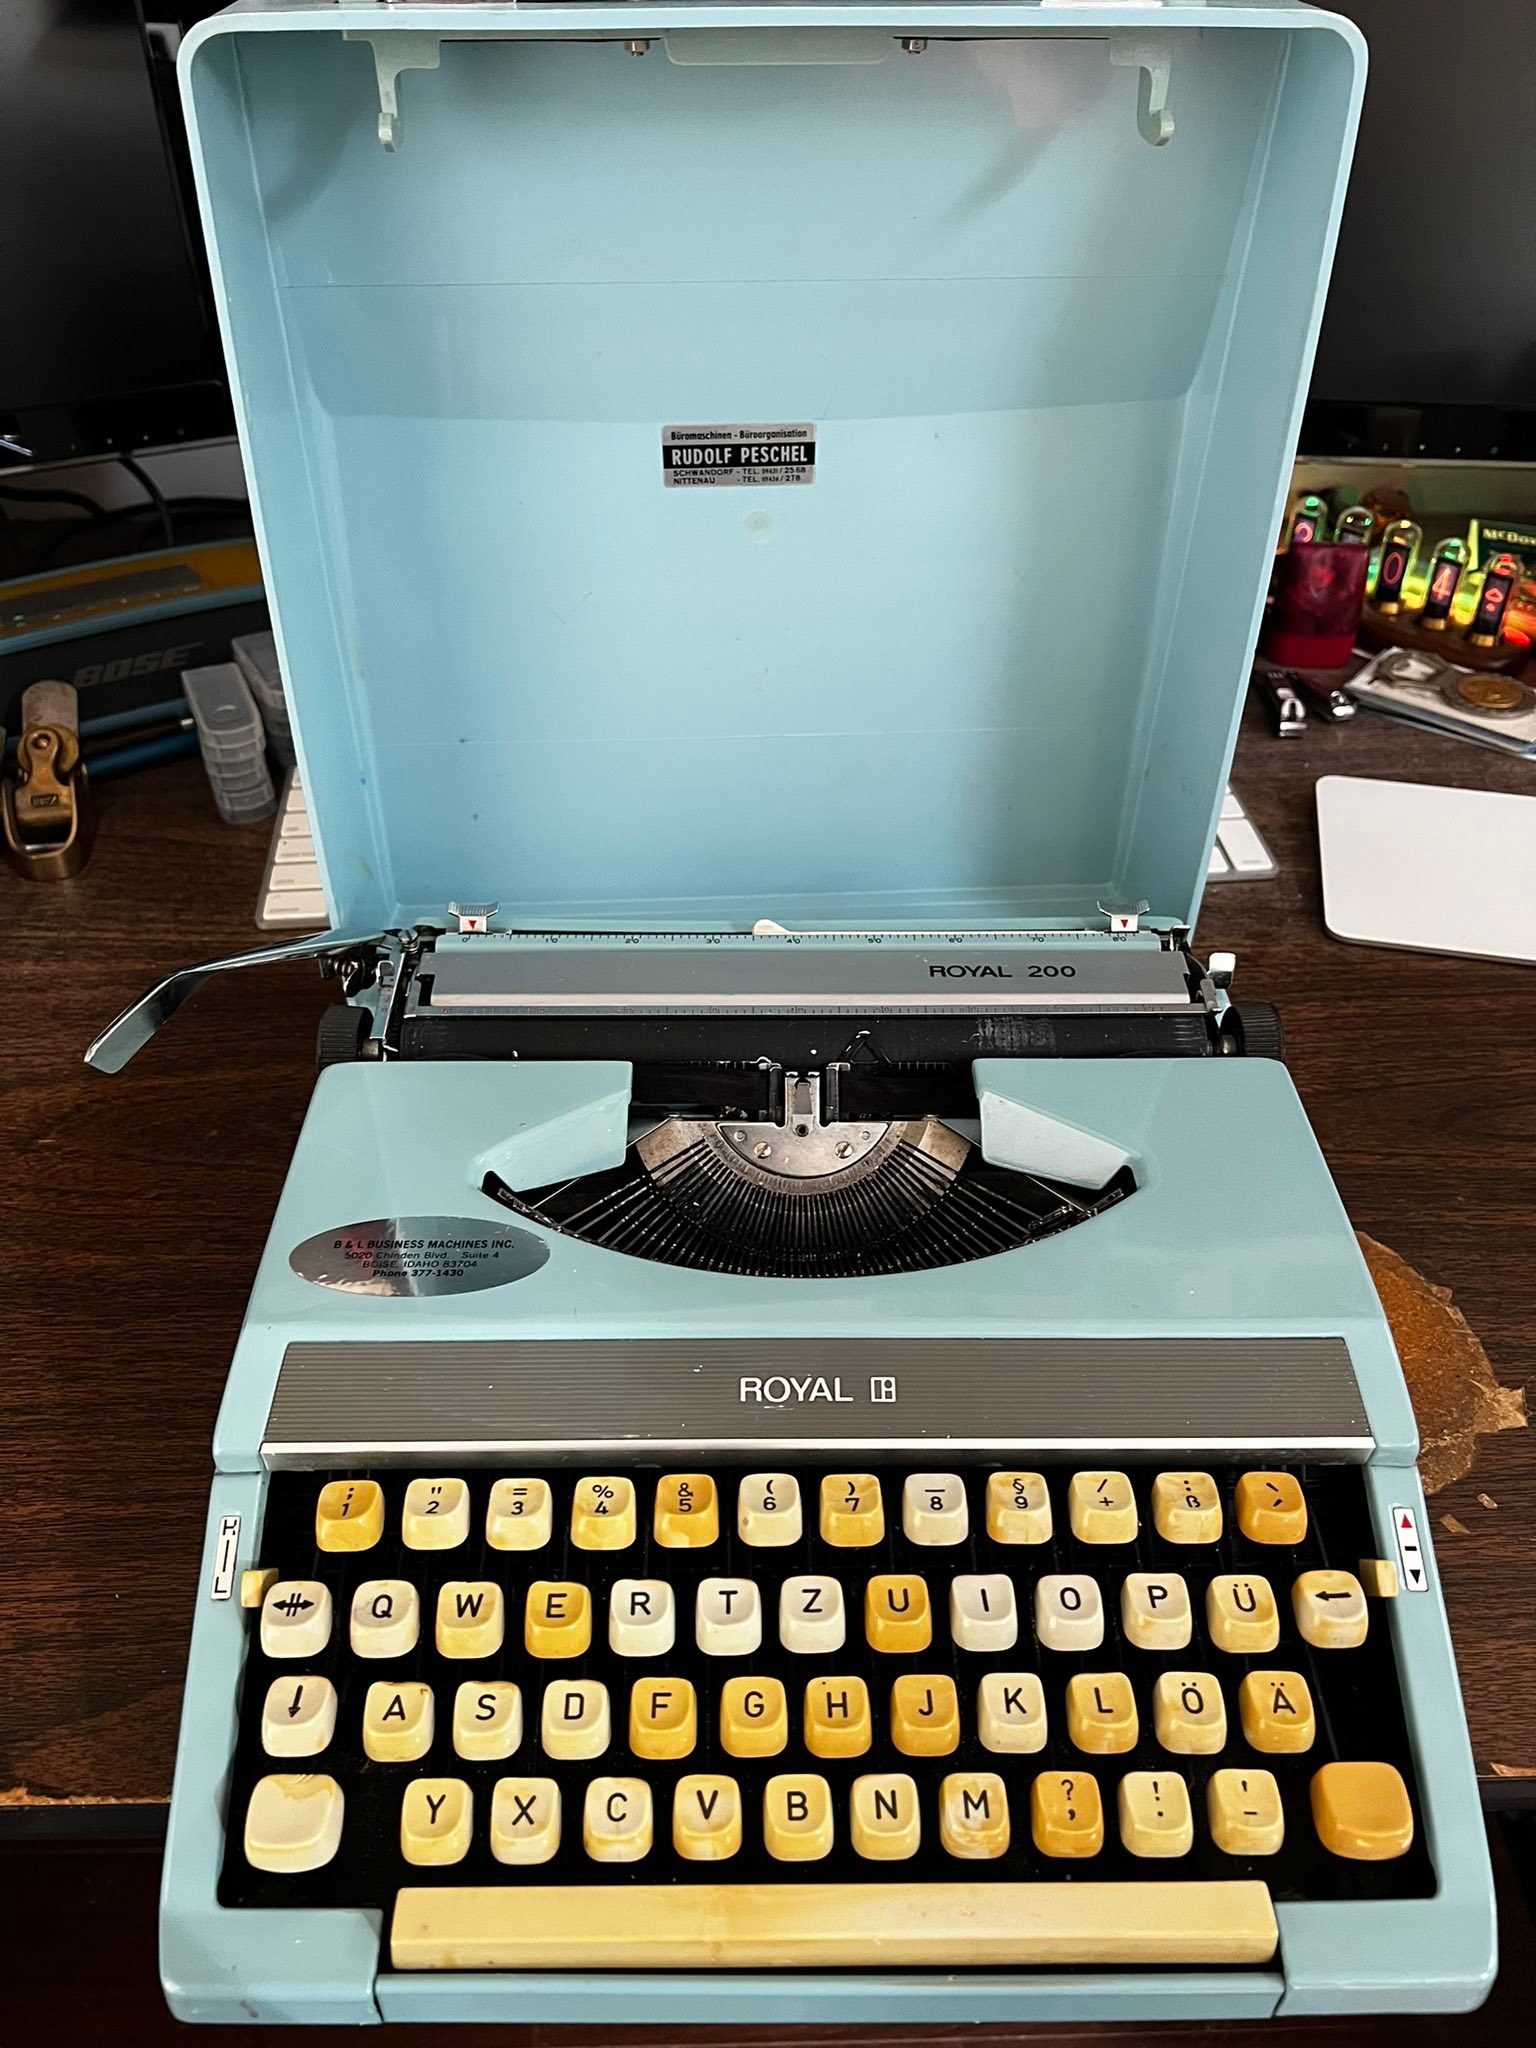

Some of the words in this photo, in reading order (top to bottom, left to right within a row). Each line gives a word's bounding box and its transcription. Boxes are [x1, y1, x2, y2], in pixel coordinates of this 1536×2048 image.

[671, 431, 732, 440] Büromaschinen
[739, 429, 808, 439] Büroorganisation
[672, 449, 732, 465] RUDOLF
[740, 446, 808, 463] PESCHEL
[673, 468, 734, 477] SCHWANDORF
[742, 467, 760, 475] TEL.
[673, 477, 716, 485] NITTENAU
[742, 475, 760, 483] TEL.
[1432, 568, 1451, 600] 4
[73, 641, 203, 687] BOSE
[929, 965, 1013, 978] ROYAL
[1027, 965, 1077, 978] 200
[334, 1240, 342, 1249] B
[345, 1240, 353, 1249] &
[357, 1240, 364, 1249] L
[367, 1240, 424, 1249] BUSINESS
[427, 1240, 488, 1249] MACHINES
[491, 1240, 515, 1249] INC.
[344, 1251, 373, 1260] 5020
[376, 1251, 420, 1260] Chinden
[424, 1251, 450, 1260] Blvd.
[461, 1251, 489, 1260] Suite
[492, 1251, 500, 1259] 4
[372, 1269, 408, 1277] Phone
[411, 1269, 464, 1277] 377-1430
[403, 1260, 440, 1269] IDAHO
[442, 1260, 477, 1269] 83704
[739, 1376, 854, 1403] ROYAL
[592, 1484, 614, 1499] %
[677, 1482, 694, 1497] &
[766, 1479, 775, 1495] (
[847, 1481, 856, 1496] )
[1012, 1478, 1025, 1495] §
[341, 1502, 350, 1517] 1
[425, 1500, 441, 1515] 2
[510, 1500, 525, 1515] 3
[594, 1500, 609, 1515] 4
[678, 1498, 693, 1513] 5
[763, 1496, 777, 1511] 6
[844, 1497, 860, 1512] 7
[930, 1496, 944, 1511] 8
[1014, 1496, 1029, 1510] 9
[1099, 1496, 1114, 1507] +
[214, 1576, 227, 1594] L
[1147, 1585, 1168, 1609] P
[371, 1594, 393, 1618] Q
[456, 1593, 484, 1618] W
[545, 1593, 568, 1618] E
[630, 1591, 651, 1615] R
[718, 1590, 738, 1614] T
[801, 1588, 823, 1613] Z
[887, 1588, 910, 1613] U
[980, 1588, 990, 1612] I
[1059, 1587, 1082, 1611] O
[1233, 1583, 1257, 1612] Ü
[382, 1694, 406, 1721] A
[475, 1694, 497, 1720] S
[563, 1692, 585, 1720] D
[651, 1692, 672, 1719] F
[743, 1691, 765, 1718] G
[826, 1691, 849, 1718] H
[918, 1689, 934, 1716] J
[1003, 1687, 1027, 1714] K
[1093, 1687, 1114, 1713] L
[1181, 1682, 1204, 1714] Ö
[1270, 1682, 1297, 1714] Ä
[1060, 1779, 1074, 1801] ?
[1152, 1781, 1161, 1801] !
[426, 1794, 446, 1824] Y
[511, 1795, 537, 1825] X
[606, 1792, 628, 1822] C
[696, 1790, 719, 1820] V
[786, 1791, 809, 1821] B
[874, 1790, 898, 1820] N
[962, 1790, 990, 1820] M
